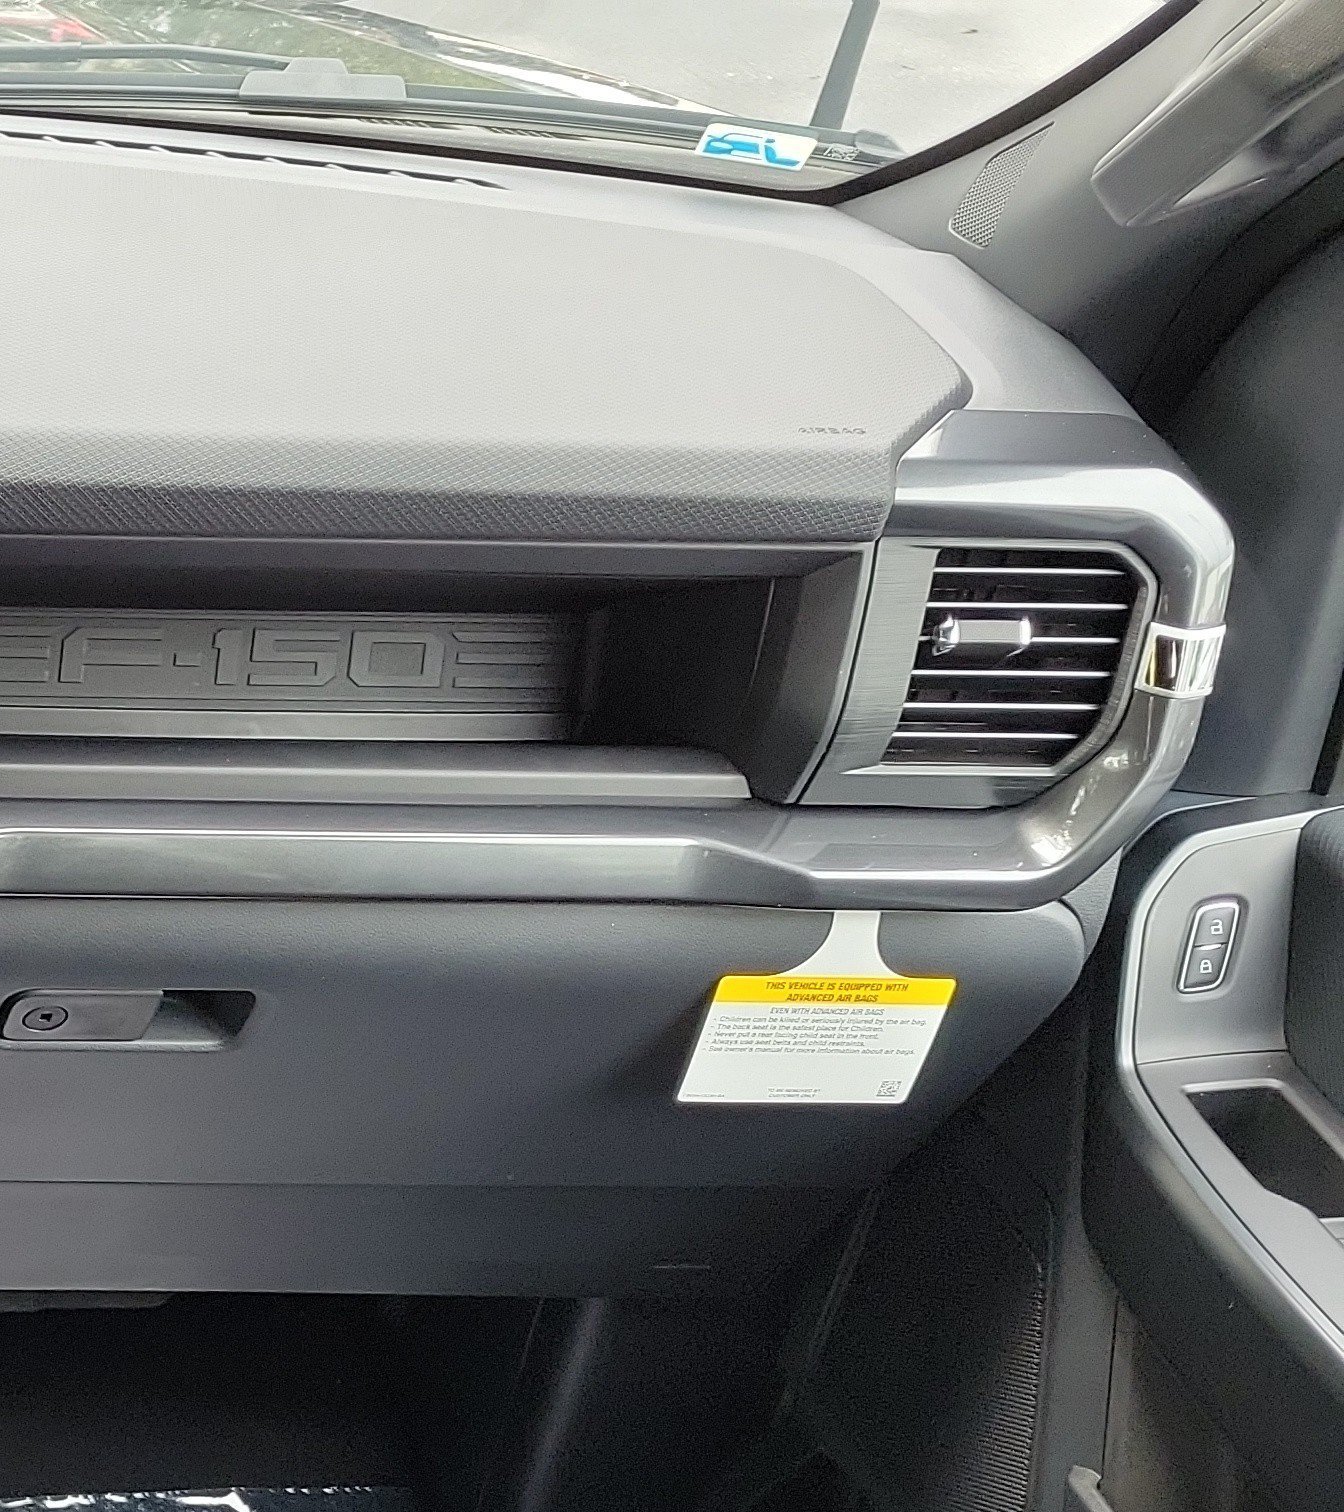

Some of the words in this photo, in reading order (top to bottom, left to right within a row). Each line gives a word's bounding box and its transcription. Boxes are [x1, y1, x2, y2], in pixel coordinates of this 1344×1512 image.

[58, 624, 445, 689] F-150
[766, 981, 786, 990] THIS
[788, 982, 825, 990] VEHICLE
[827, 982, 837, 990] IS
[838, 982, 883, 991] EQUIPPED
[885, 983, 909, 992] WITH
[786, 993, 834, 1002] ADVANCED
[836, 994, 852, 1002] AIR
[854, 994, 879, 1003] BAGS
